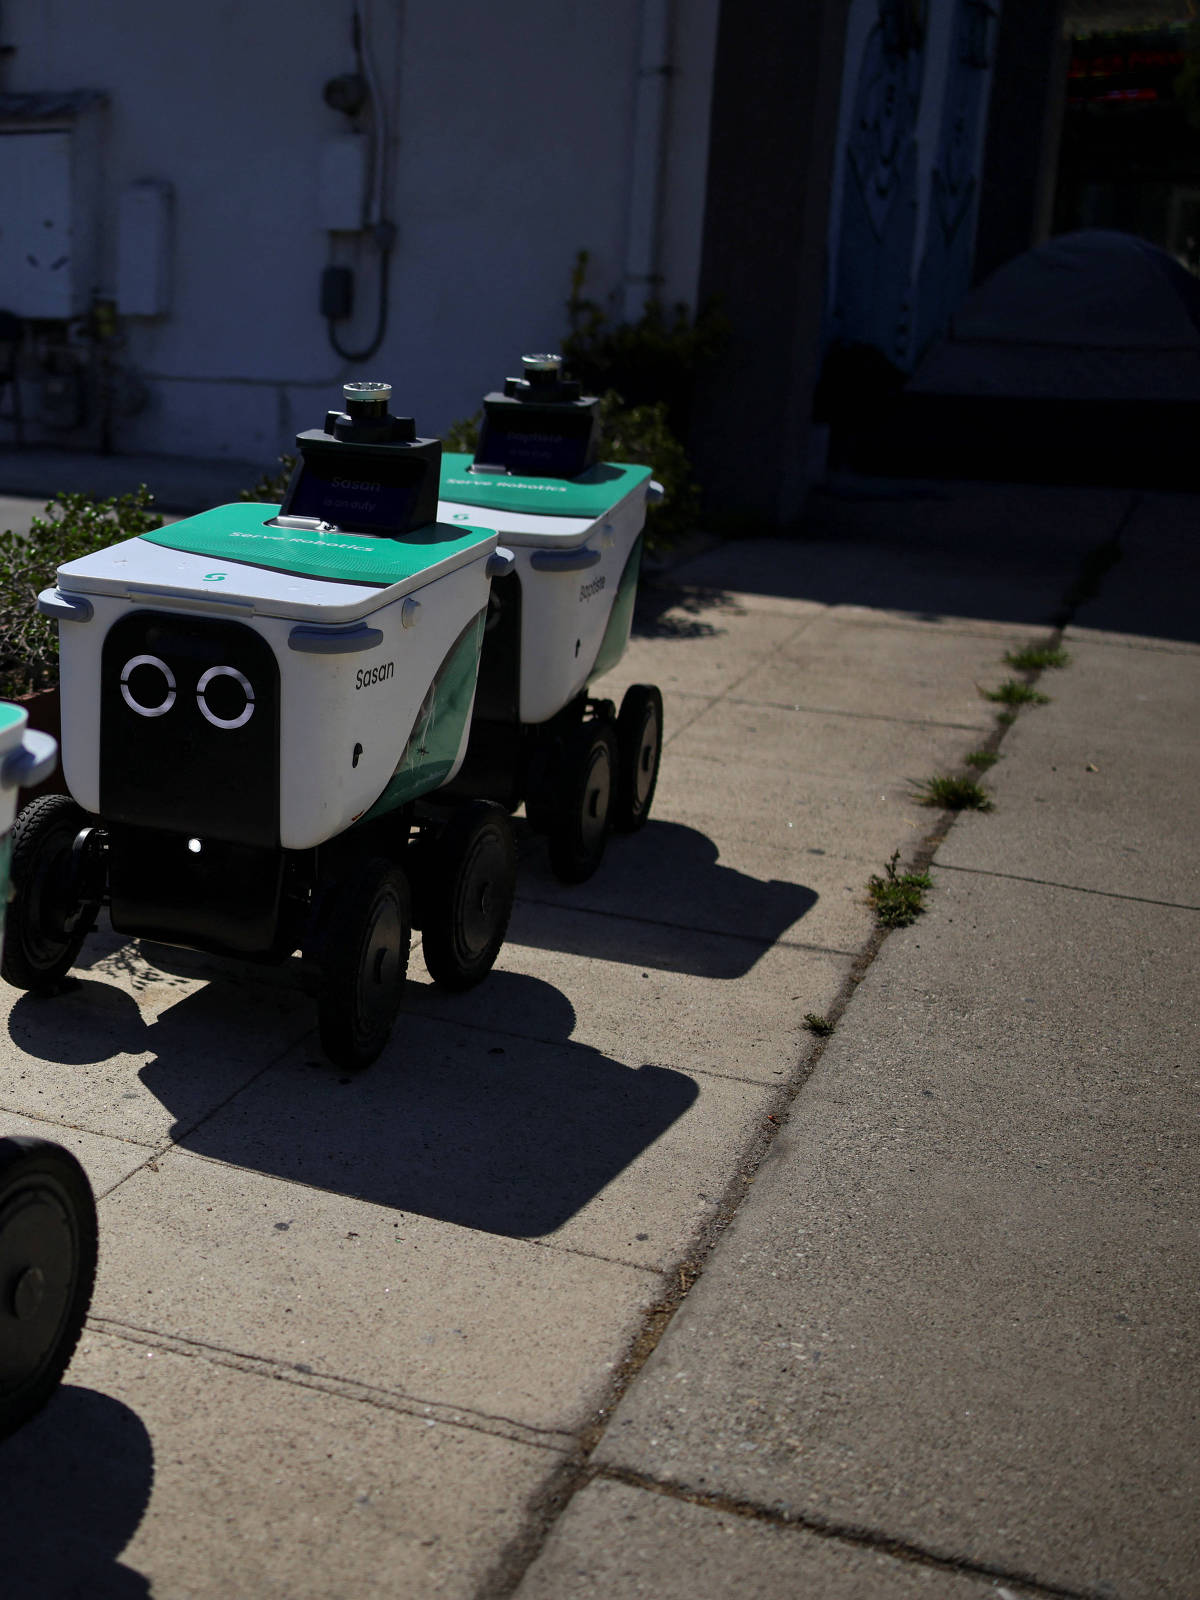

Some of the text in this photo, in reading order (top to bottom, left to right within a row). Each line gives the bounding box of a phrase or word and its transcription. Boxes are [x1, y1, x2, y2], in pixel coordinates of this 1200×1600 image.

[330, 475, 382, 493] Sasan
[228, 531, 375, 552] Serve Robotics
[355, 661, 395, 690] Sasan
